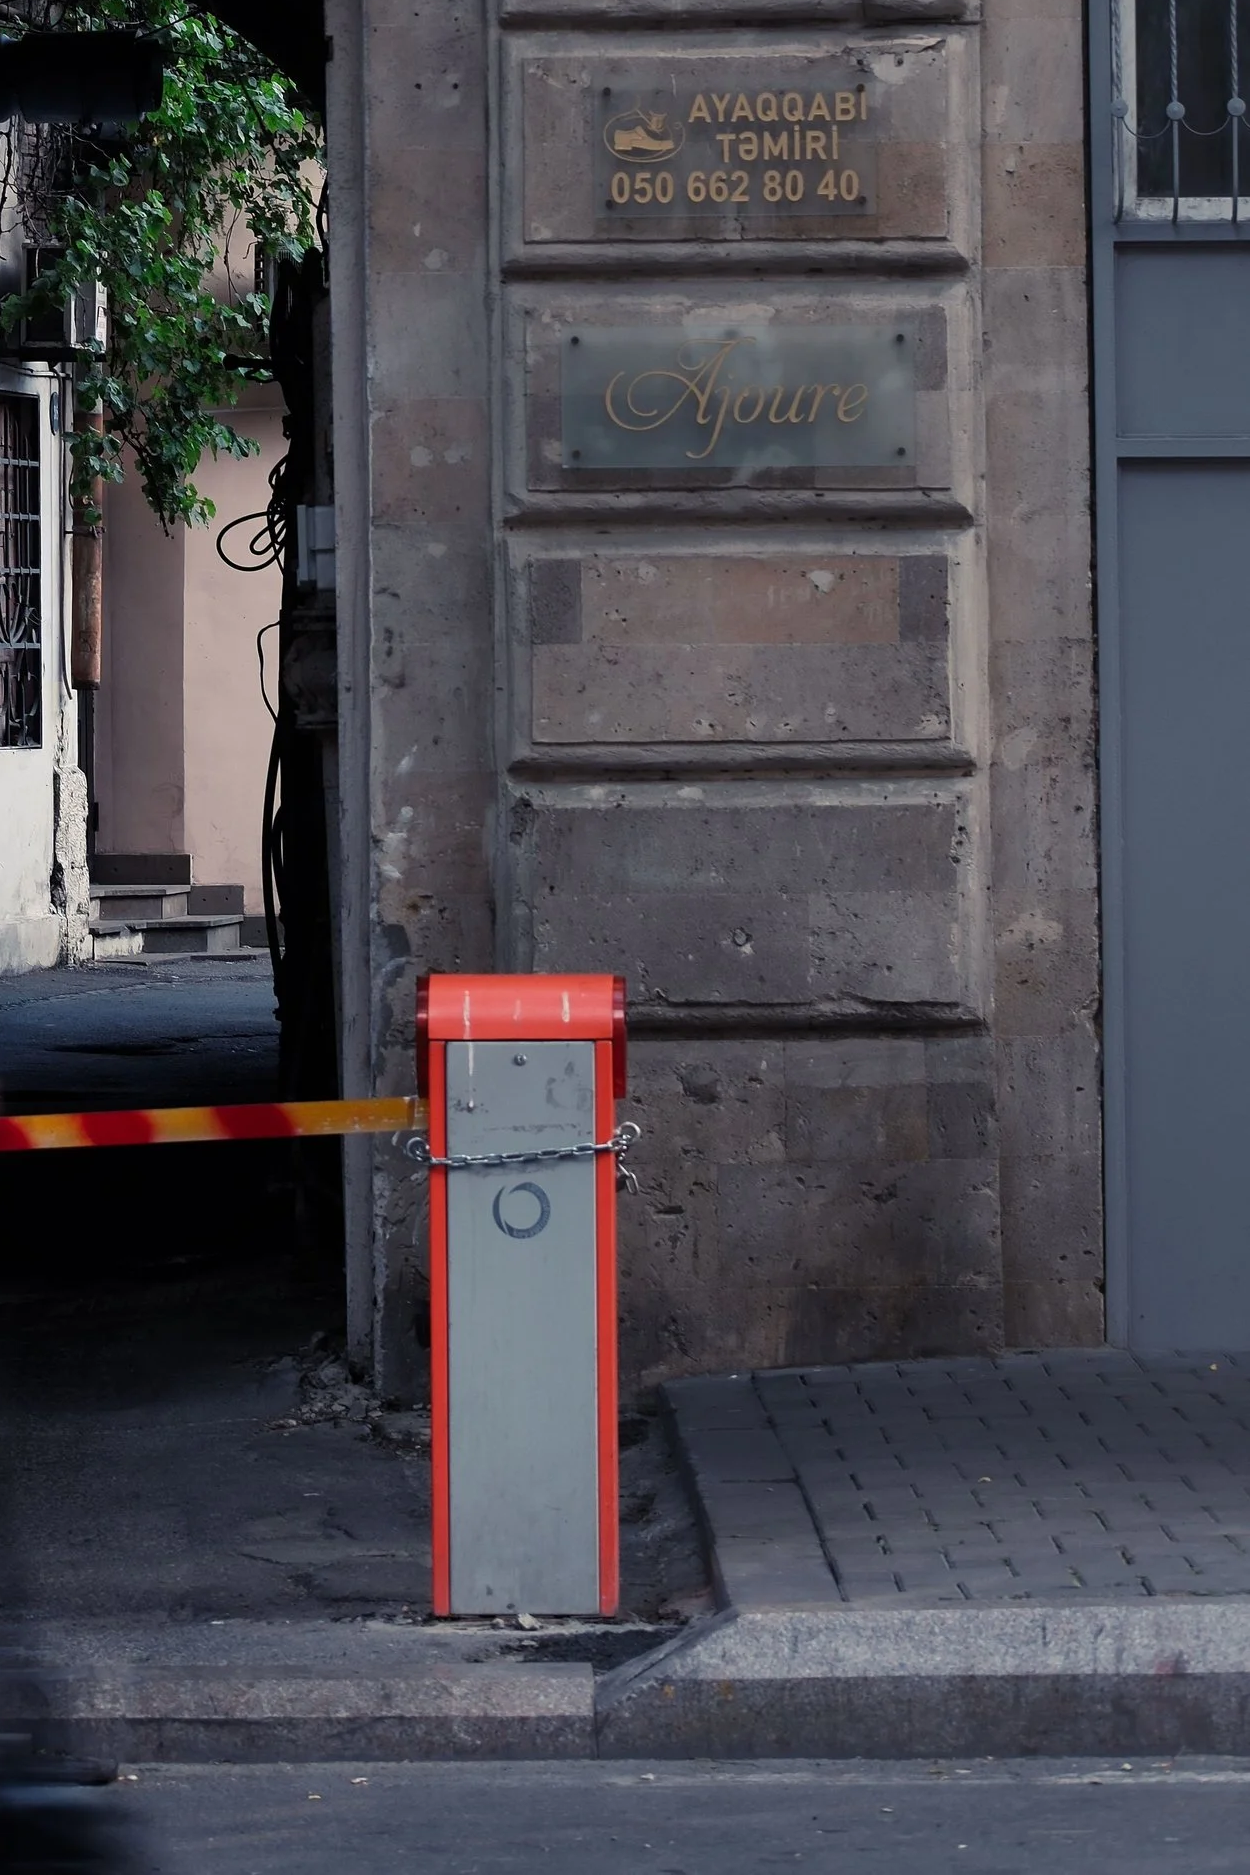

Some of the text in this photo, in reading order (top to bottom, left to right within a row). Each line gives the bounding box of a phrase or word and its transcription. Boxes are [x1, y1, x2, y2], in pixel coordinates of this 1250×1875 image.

[688, 91, 868, 123] AYAQQABI
[716, 125, 839, 163] TƏMİRİ
[611, 169, 859, 204] 050 662 80 40
[605, 336, 868, 459] Ajoure
